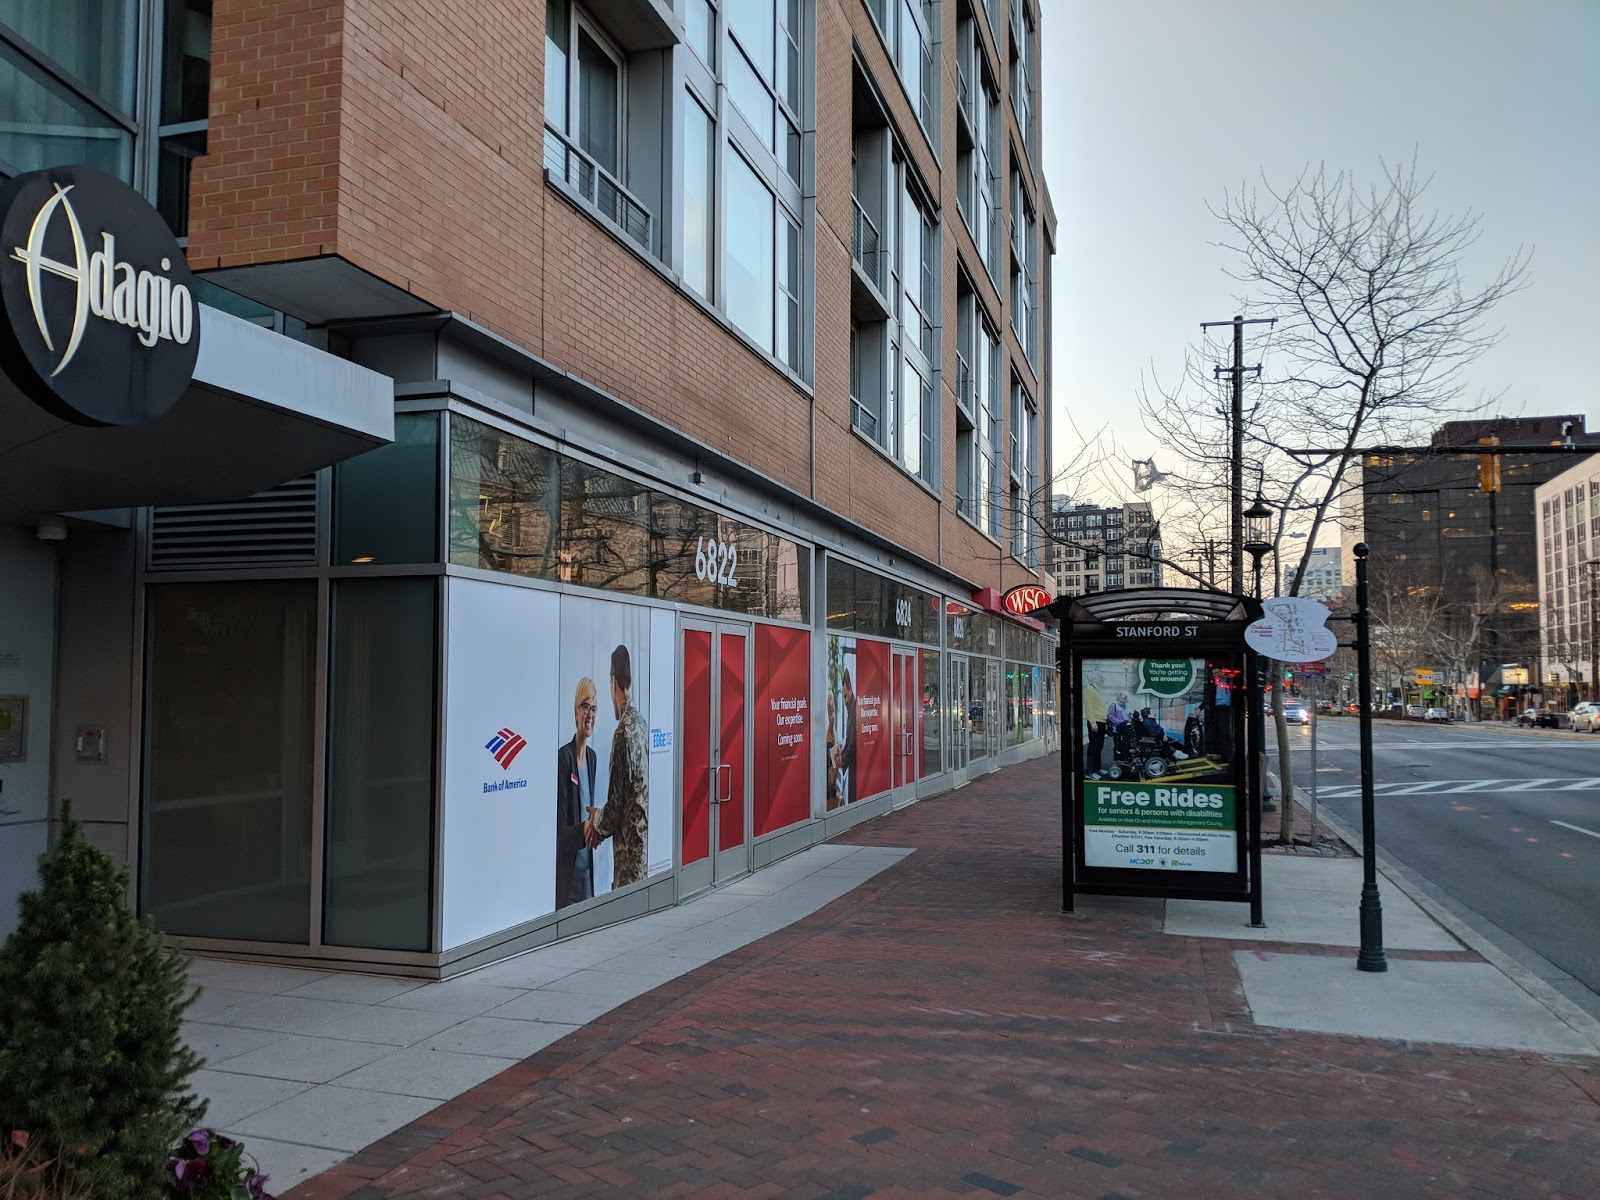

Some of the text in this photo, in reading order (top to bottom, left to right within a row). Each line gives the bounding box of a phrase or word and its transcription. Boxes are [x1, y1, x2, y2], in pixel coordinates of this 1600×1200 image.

[10, 183, 193, 377] Adagio
[695, 536, 738, 588] 6822
[1010, 589, 1046, 614] WSC
[896, 599, 911, 627] 6824
[1116, 626, 1199, 637] STANFORD ST
[770, 697, 807, 711] Your financial goals.
[776, 712, 803, 727] Our expertise.
[653, 733, 666, 748] EDGE
[778, 733, 803, 747] Coming soon.
[483, 778, 527, 793] Bank of America
[1098, 787, 1223, 808] Free Rides
[1109, 807, 1133, 815] seniors
[1141, 809, 1169, 818] persons
[1170, 809, 1185, 817] with
[1186, 810, 1223, 818] disabilities
[1115, 844, 1206, 856] Call 311 for details
